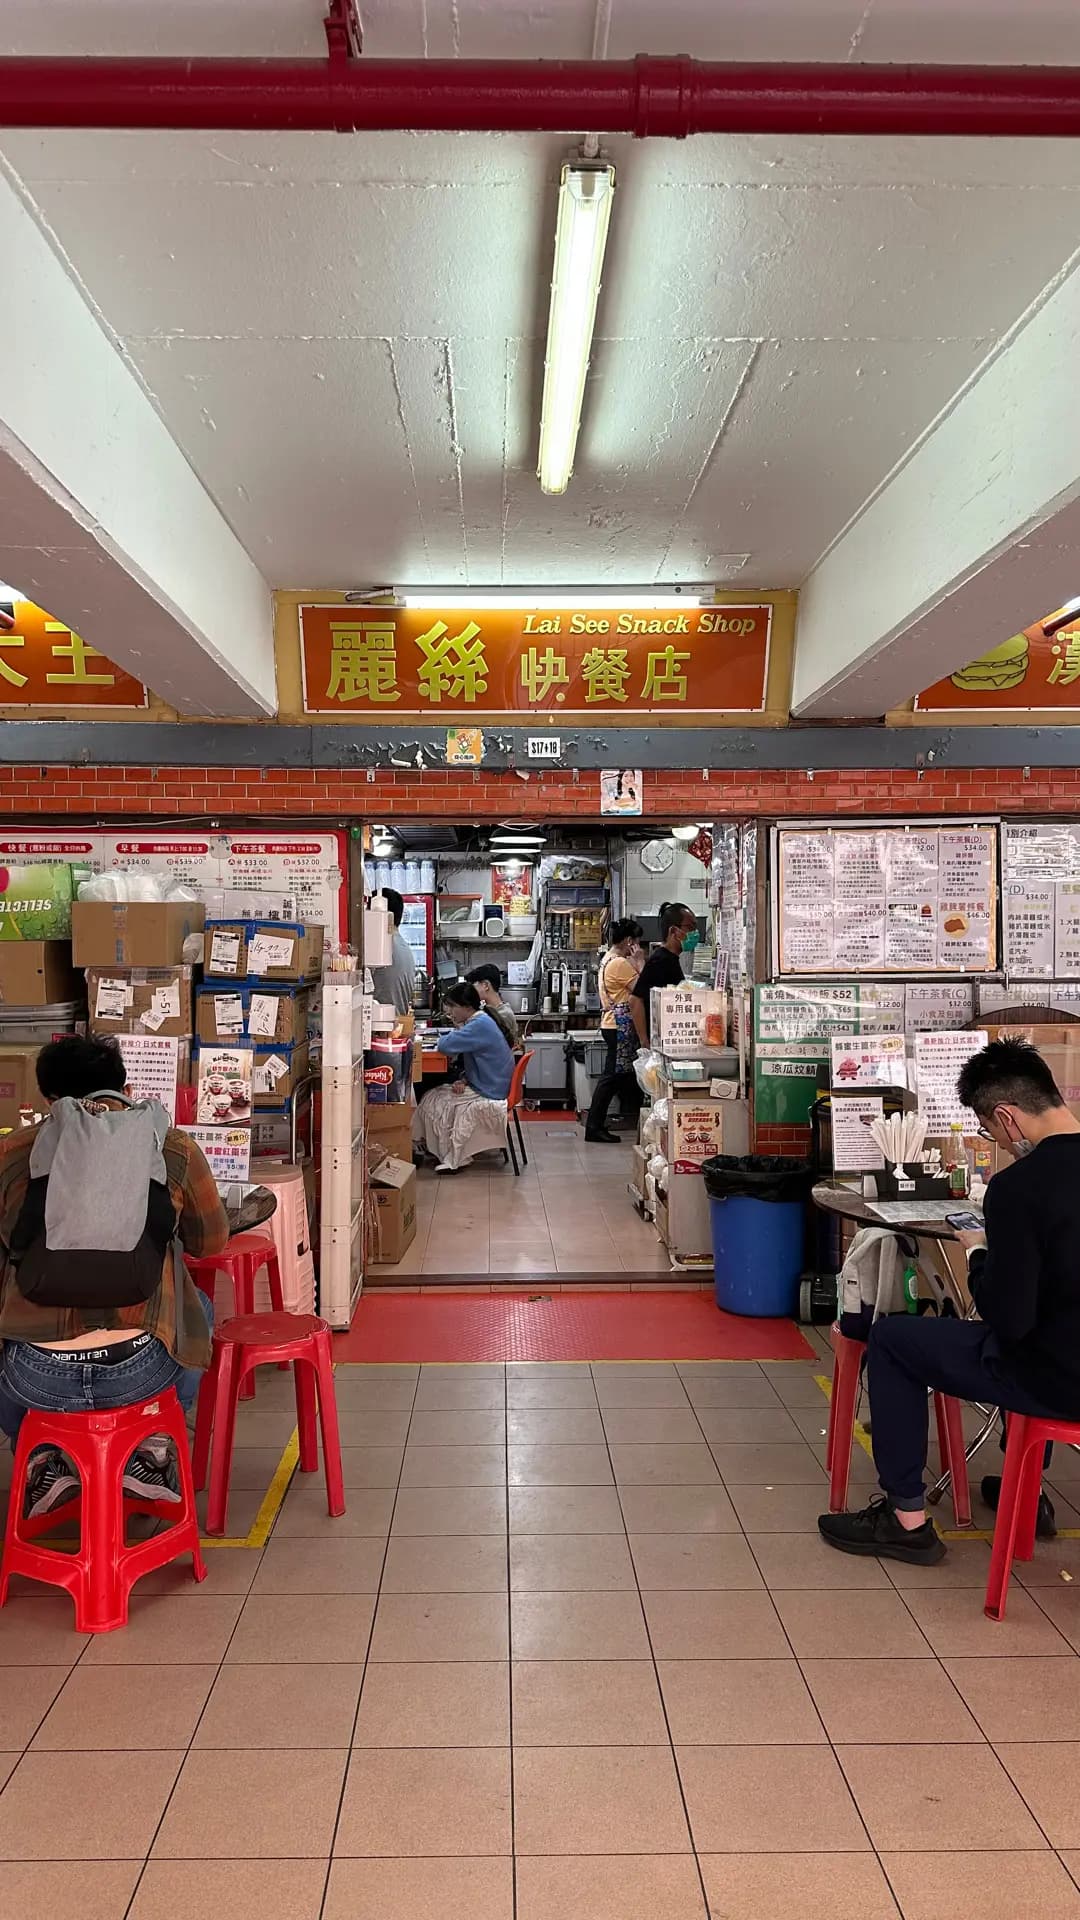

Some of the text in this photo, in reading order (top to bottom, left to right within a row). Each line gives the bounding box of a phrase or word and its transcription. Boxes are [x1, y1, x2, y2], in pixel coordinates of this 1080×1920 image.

[522, 613, 756, 638] Lai See Snack Shop
[531, 742, 557, 754] S17+18
[233, 844, 266, 853] 下午茶餐
[675, 993, 693, 1002] 外賣
[833, 990, 852, 999] $52
[666, 1004, 702, 1013] 專用餐具
[51, 1349, 109, 1361] Nanjiren
